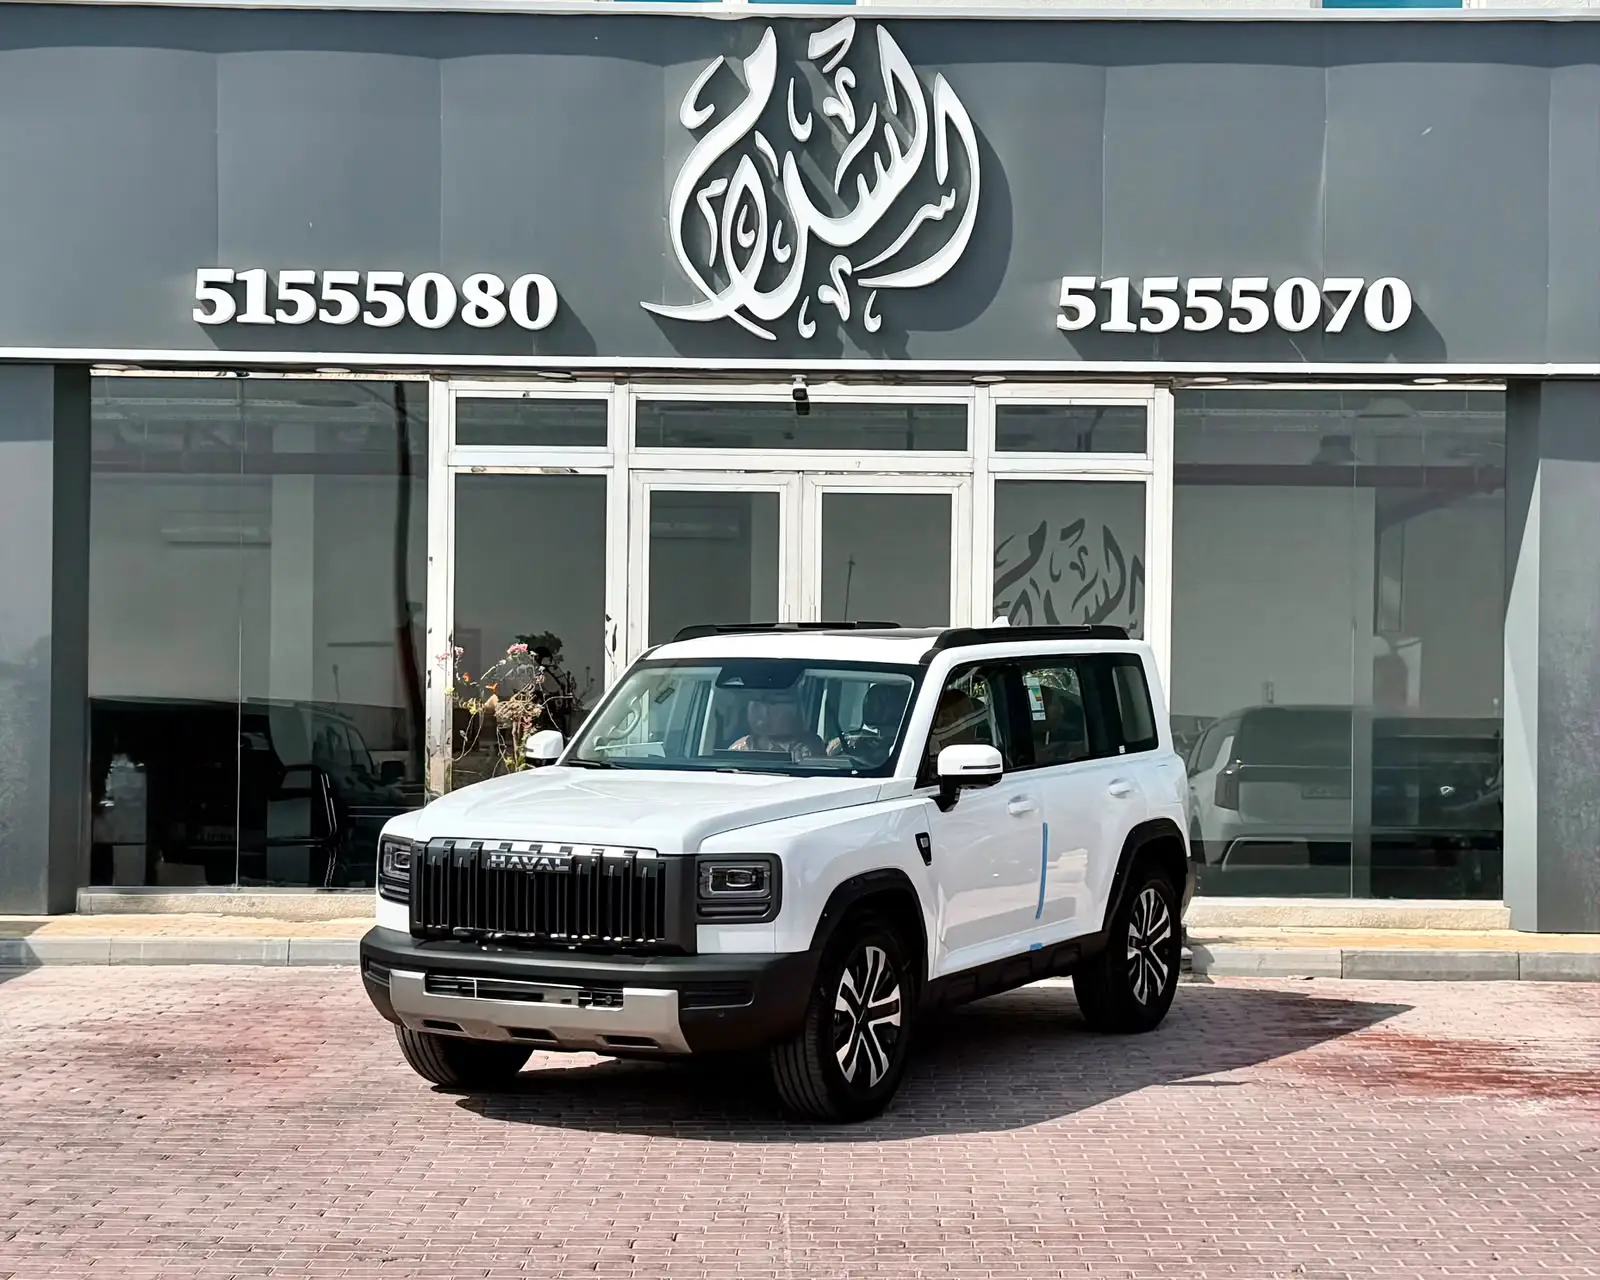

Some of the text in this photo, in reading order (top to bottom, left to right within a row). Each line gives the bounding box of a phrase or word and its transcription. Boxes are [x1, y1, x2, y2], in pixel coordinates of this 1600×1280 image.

[193, 268, 558, 330] 51555080
[1056, 275, 1412, 333] 51555070
[490, 855, 569, 870] HAVAL
